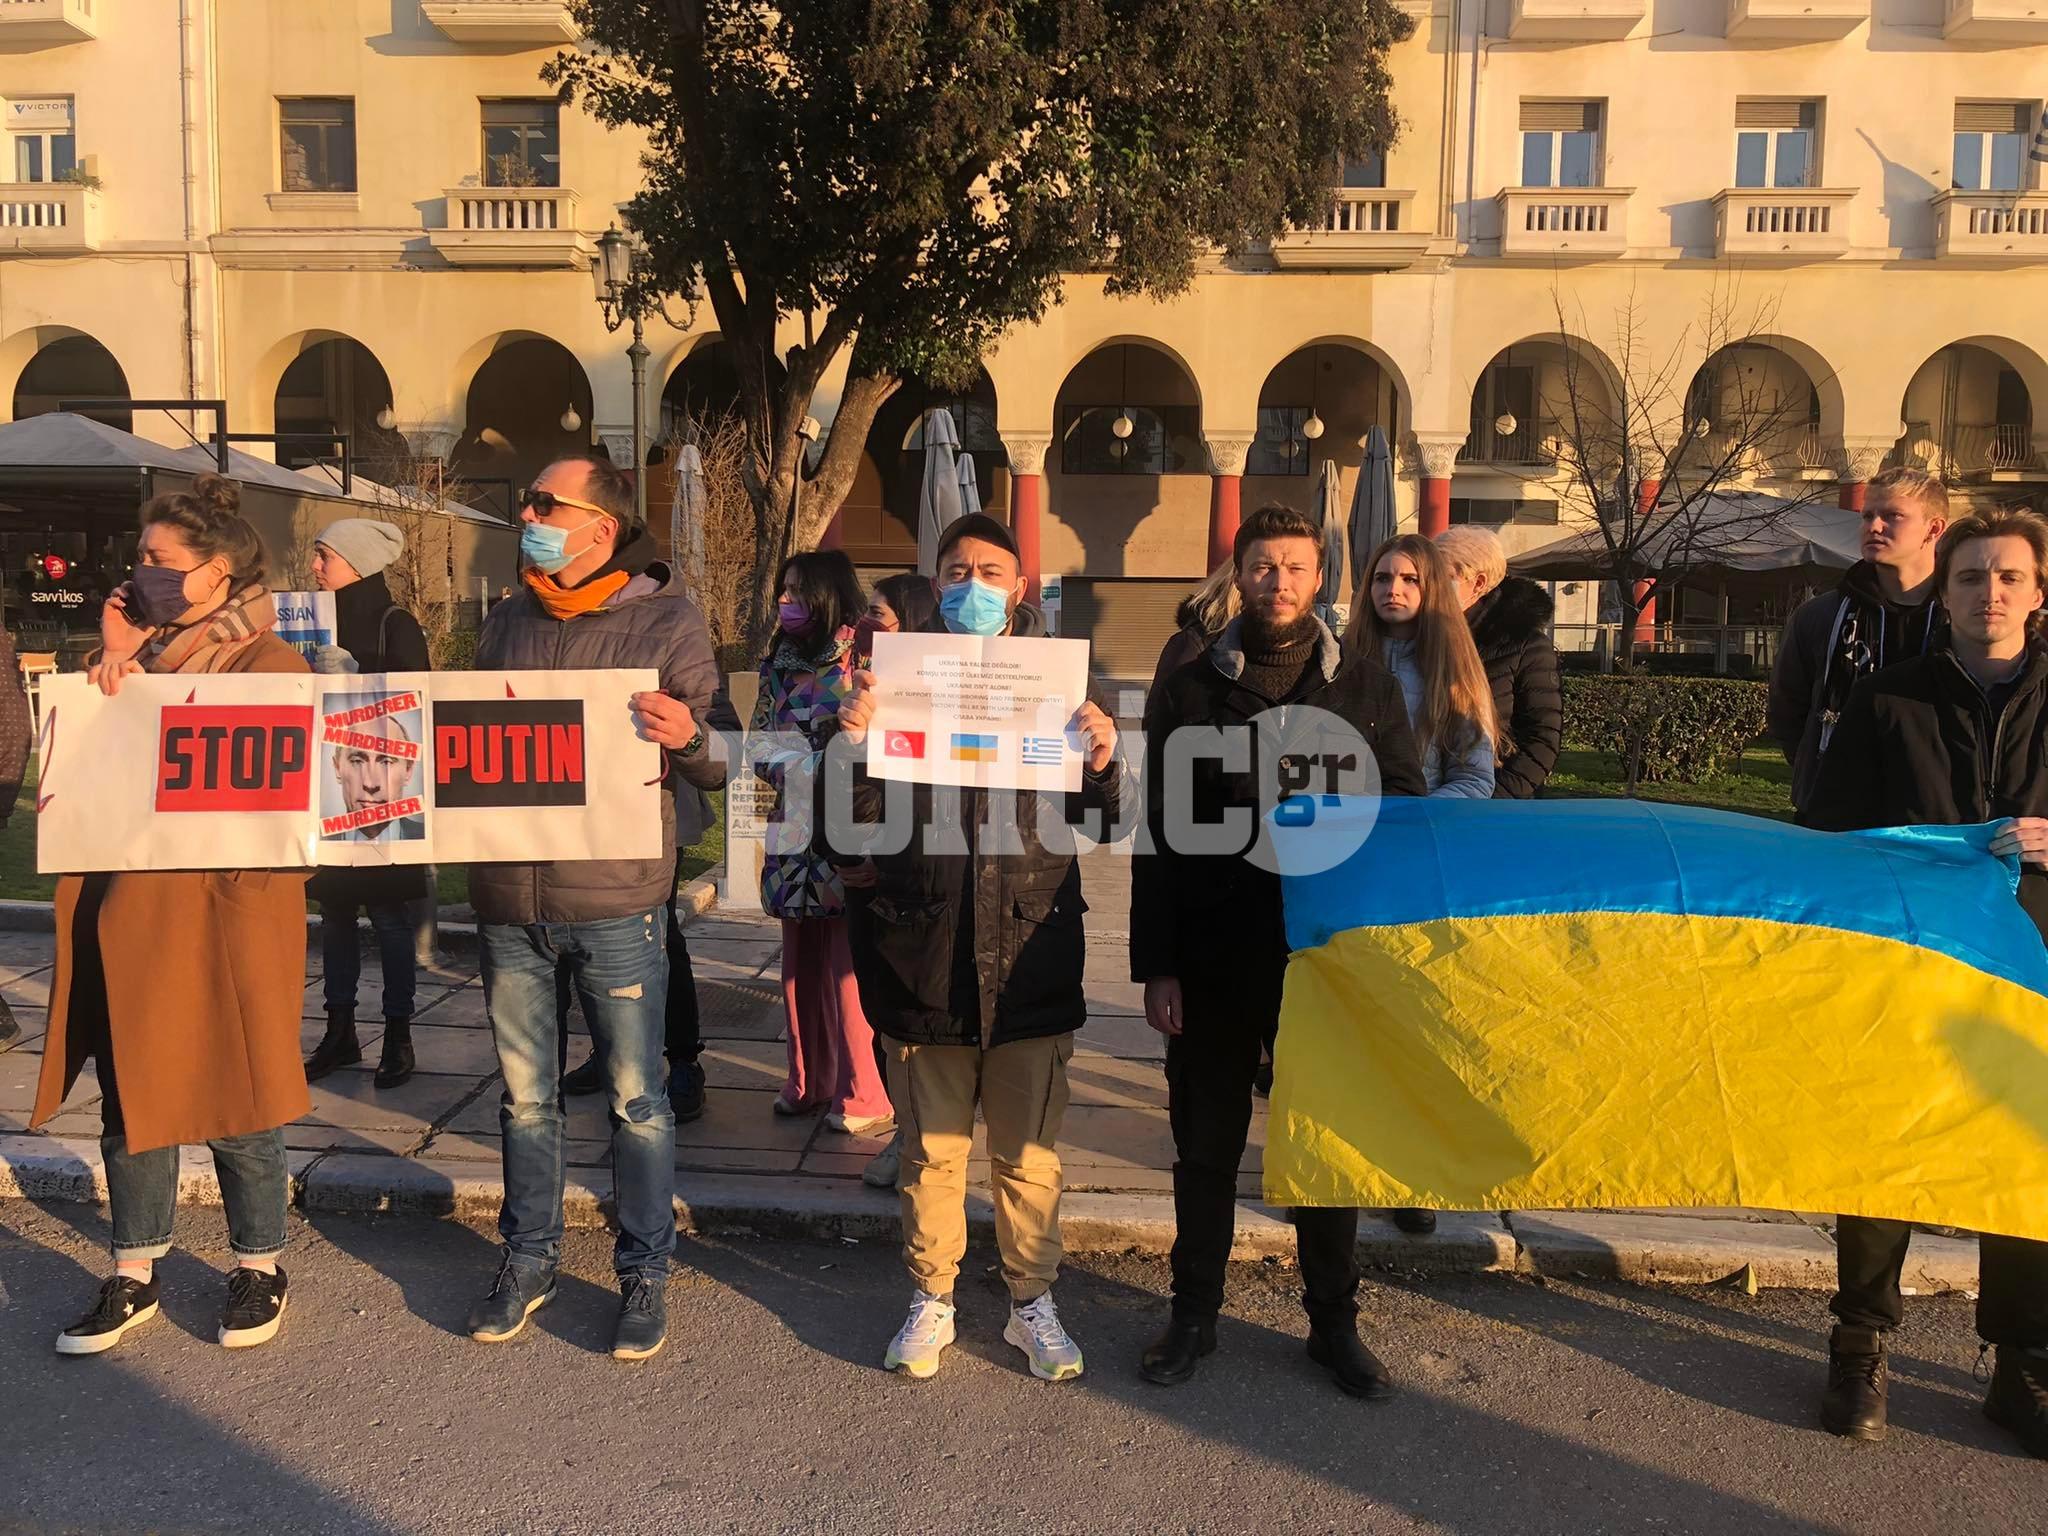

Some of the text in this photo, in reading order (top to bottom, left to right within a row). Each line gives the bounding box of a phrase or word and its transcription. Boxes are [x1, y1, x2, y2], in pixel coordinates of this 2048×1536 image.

[31, 589, 84, 603] savvikos
[324, 693, 417, 728] MURDERER
[164, 725, 307, 790] STOP
[324, 727, 417, 759] MURDERER
[435, 724, 583, 784] PUTIN
[323, 797, 422, 834] MURDERER
